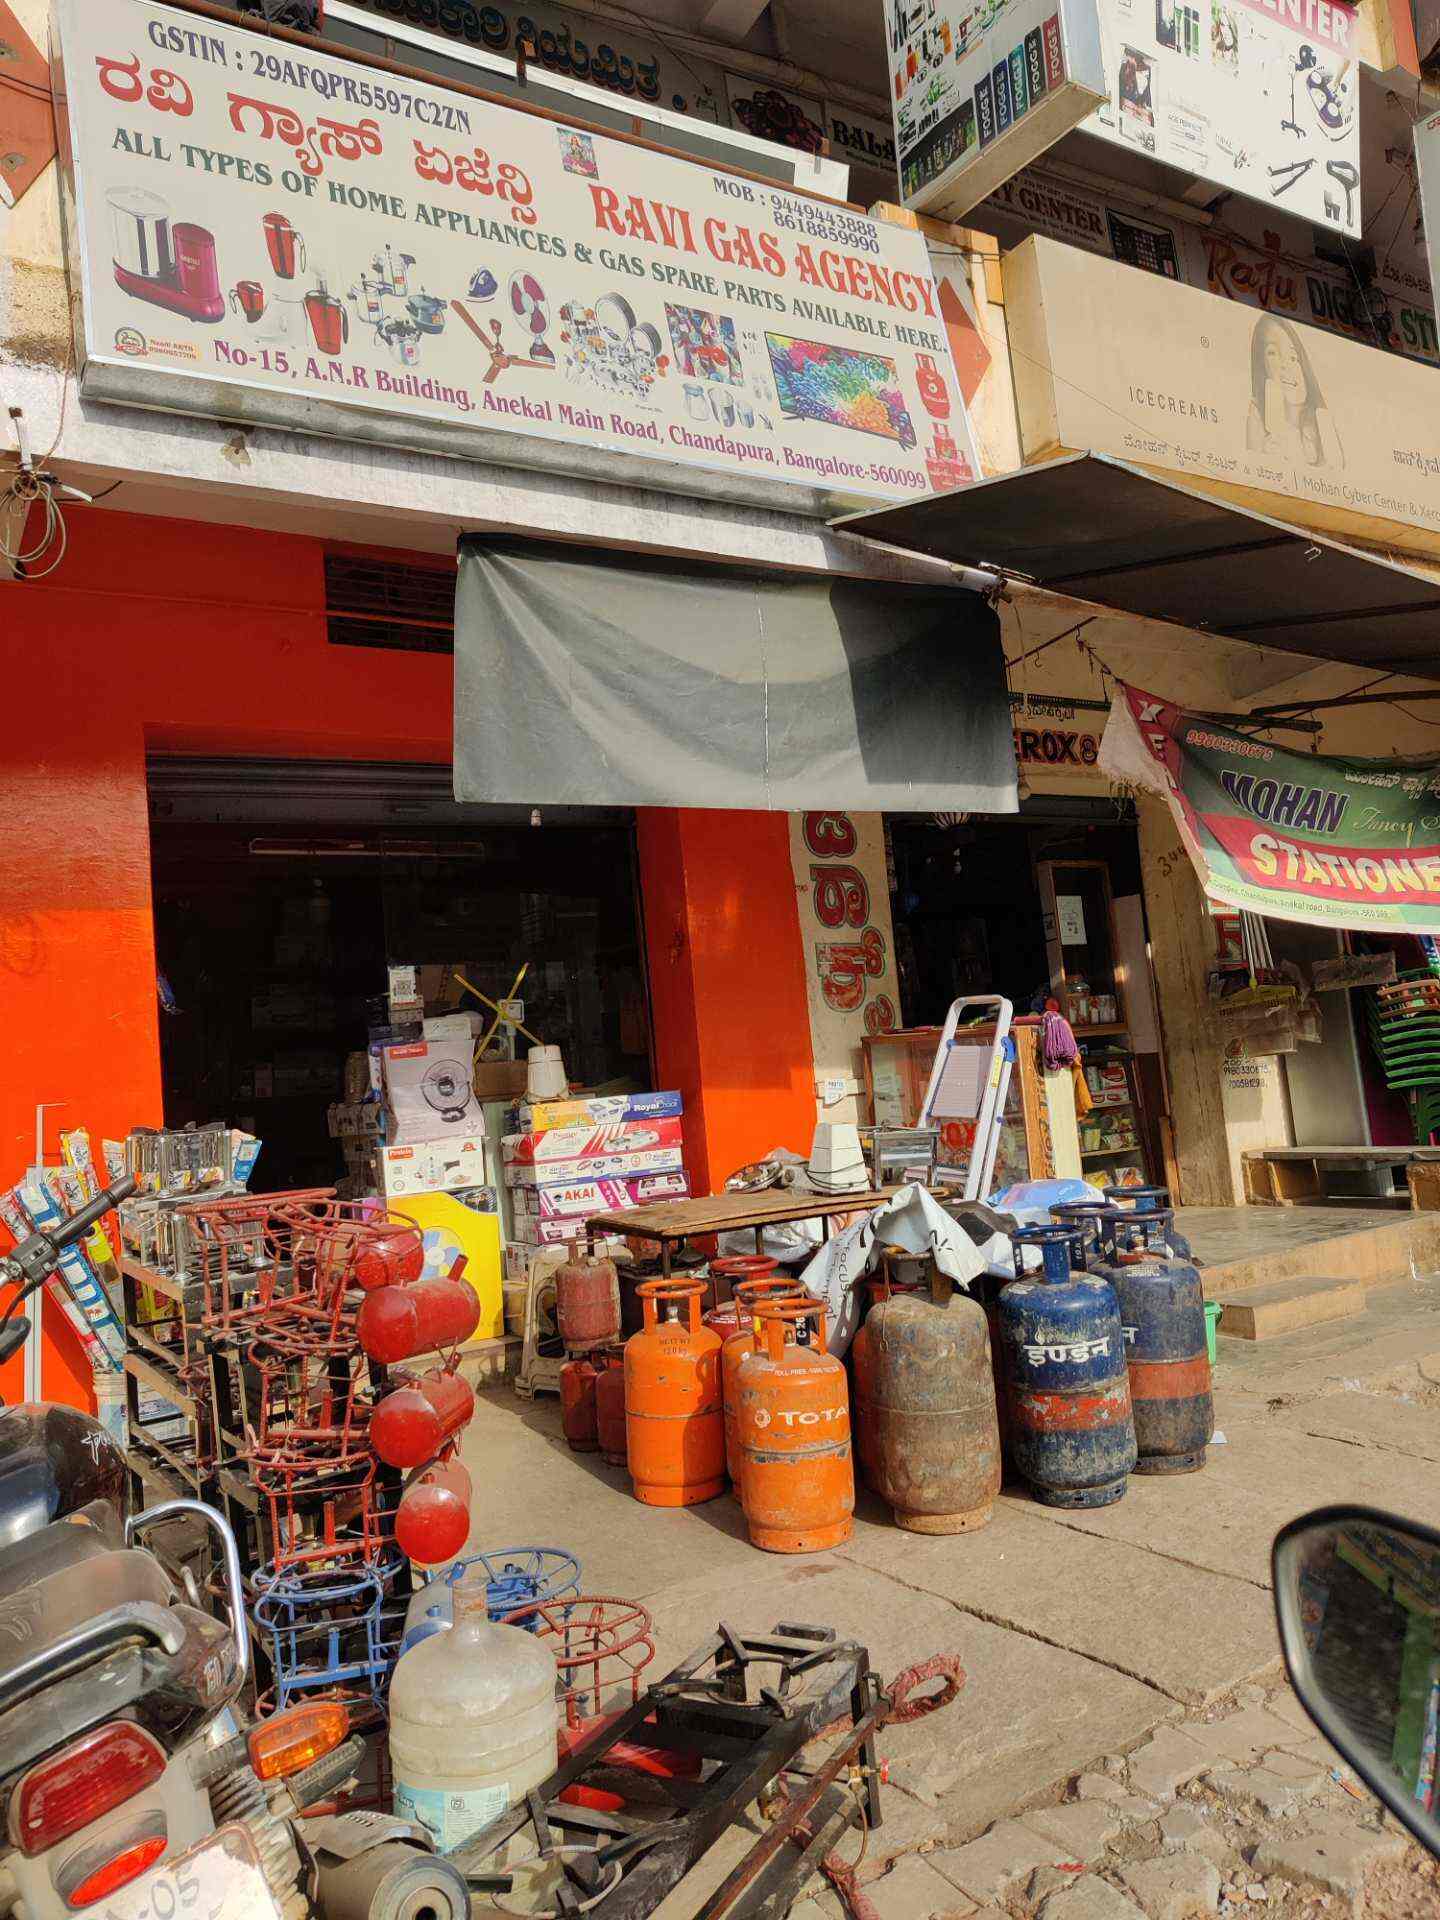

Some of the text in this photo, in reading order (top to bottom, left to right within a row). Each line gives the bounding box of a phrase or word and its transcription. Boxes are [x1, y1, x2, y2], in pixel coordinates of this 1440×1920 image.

[148, 20, 226, 66] GSTIN
[95, 52, 194, 117] ರವಿ
[226, 91, 384, 177] ಗ್ಯಾಸ್
[713, 176, 754, 207] MOB
[770, 193, 878, 239] 9449443888
[773, 211, 880, 254] 8618859990
[112, 127, 948, 354] ALL TYPES OF HOME APPLIANCES & GAS SPARE PARTS AVAILABLE HERE.
[588, 183, 937, 318] RAVI GAS AGENCY
[213, 339, 298, 379] No-15,
[304, 357, 368, 389] A.N.R
[376, 370, 477, 411] Building,
[482, 388, 552, 422] Anekal
[557, 404, 604, 432] Main
[611, 413, 664, 445] Road,
[668, 425, 781, 467] Chandapura,
[783, 447, 926, 491] Bangalore-560099
[1129, 385, 1219, 423] ICECREAMS
[1303, 476, 1340, 497] Mohan
[1220, 770, 1349, 833] MOHAN
[563, 1187, 594, 1201] AKAI
[777, 1406, 847, 1427] TOTA
